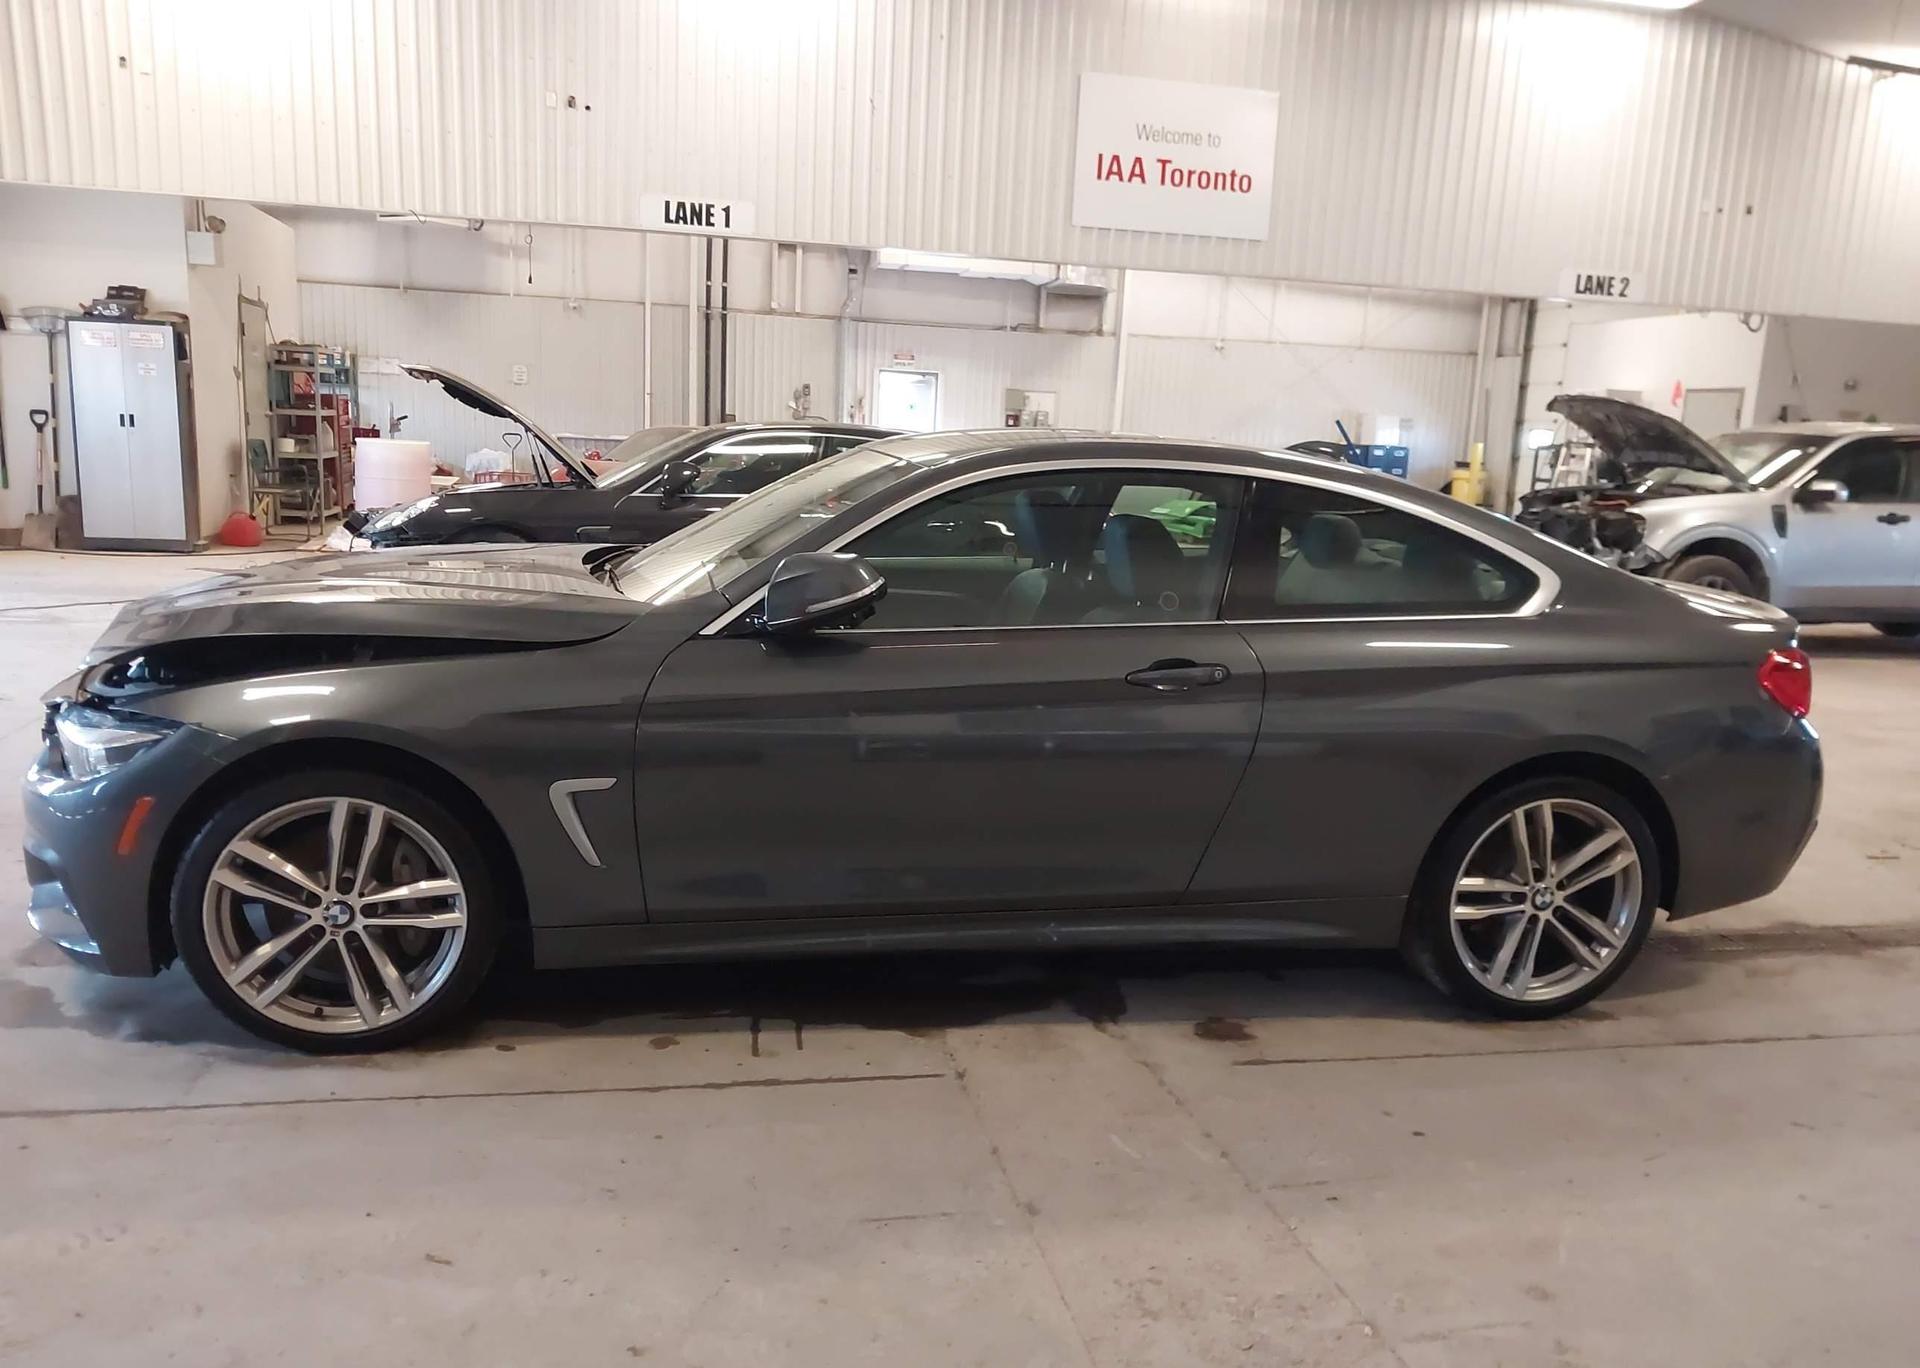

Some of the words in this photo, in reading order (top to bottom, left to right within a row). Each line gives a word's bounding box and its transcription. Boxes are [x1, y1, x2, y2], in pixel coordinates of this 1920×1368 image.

[1136, 123, 1203, 146] Welcome
[1207, 132, 1222, 148] to
[1096, 153, 1146, 184] IAA
[1156, 158, 1252, 193] Toronto
[664, 200, 715, 227] LANE
[721, 205, 730, 228] 1
[1575, 274, 1615, 296] LANE
[1618, 277, 1630, 297] 2
